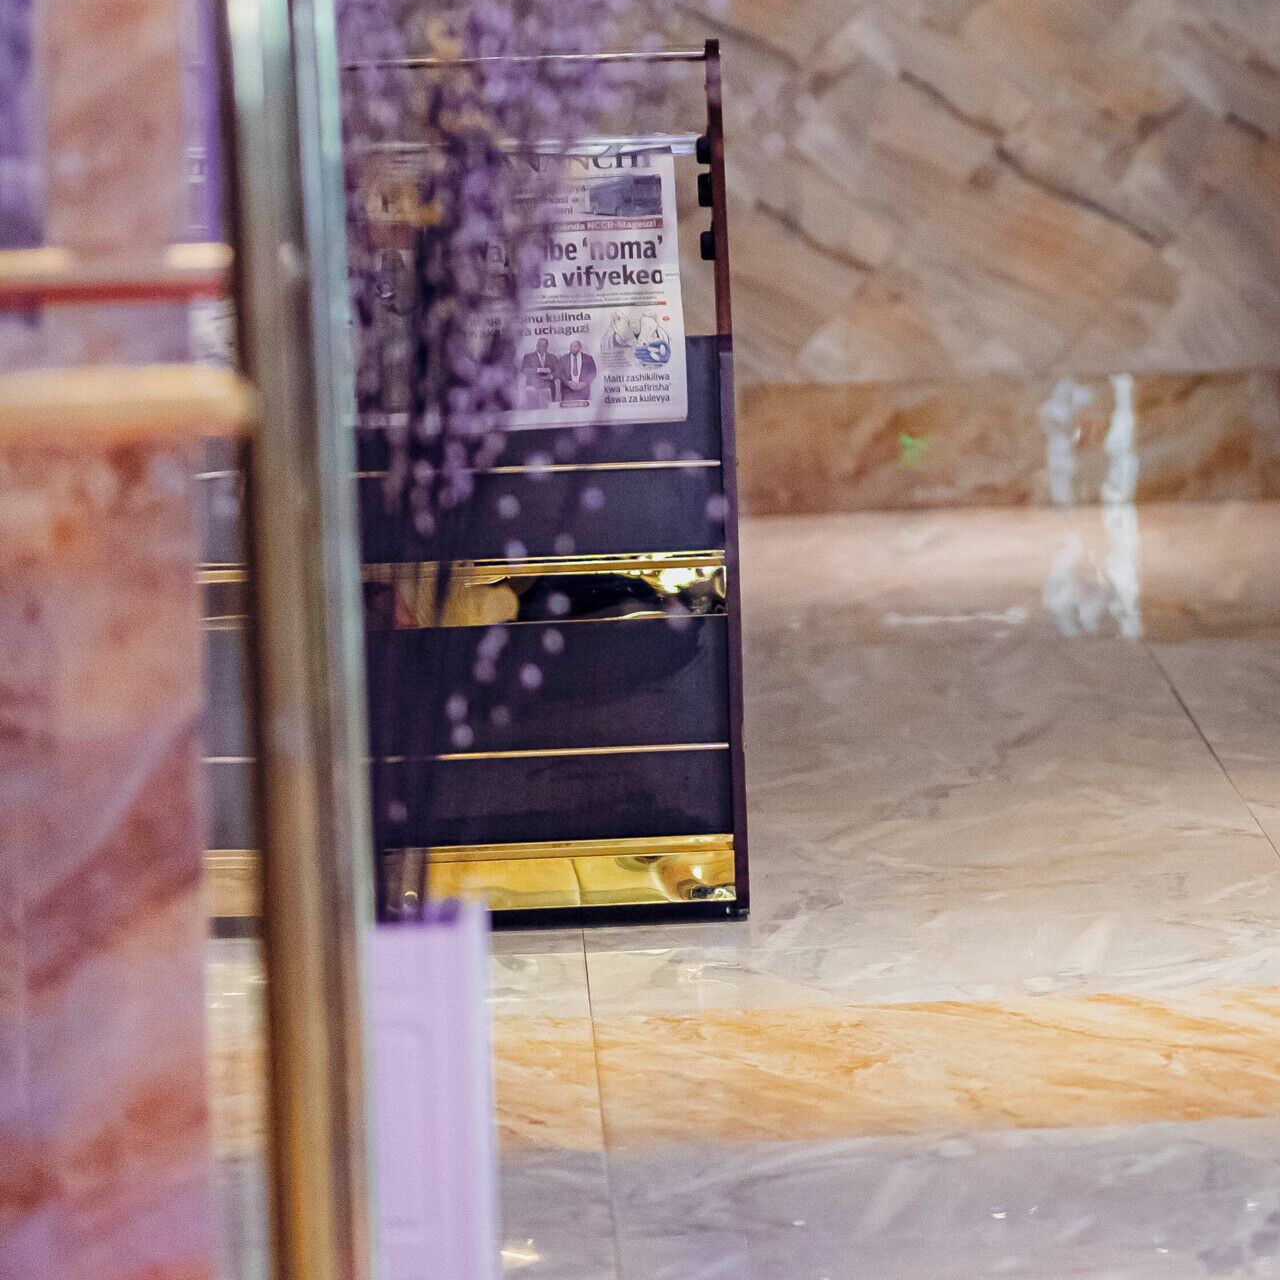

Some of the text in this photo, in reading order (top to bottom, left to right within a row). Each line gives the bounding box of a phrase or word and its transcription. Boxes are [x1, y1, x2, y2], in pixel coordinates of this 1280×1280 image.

[545, 311, 591, 323] kulinda
[534, 322, 590, 336] uchaguzi
[603, 373, 625, 383] Maiti
[604, 384, 621, 393] kwa
[604, 393, 671, 404] dawa za kulevya
